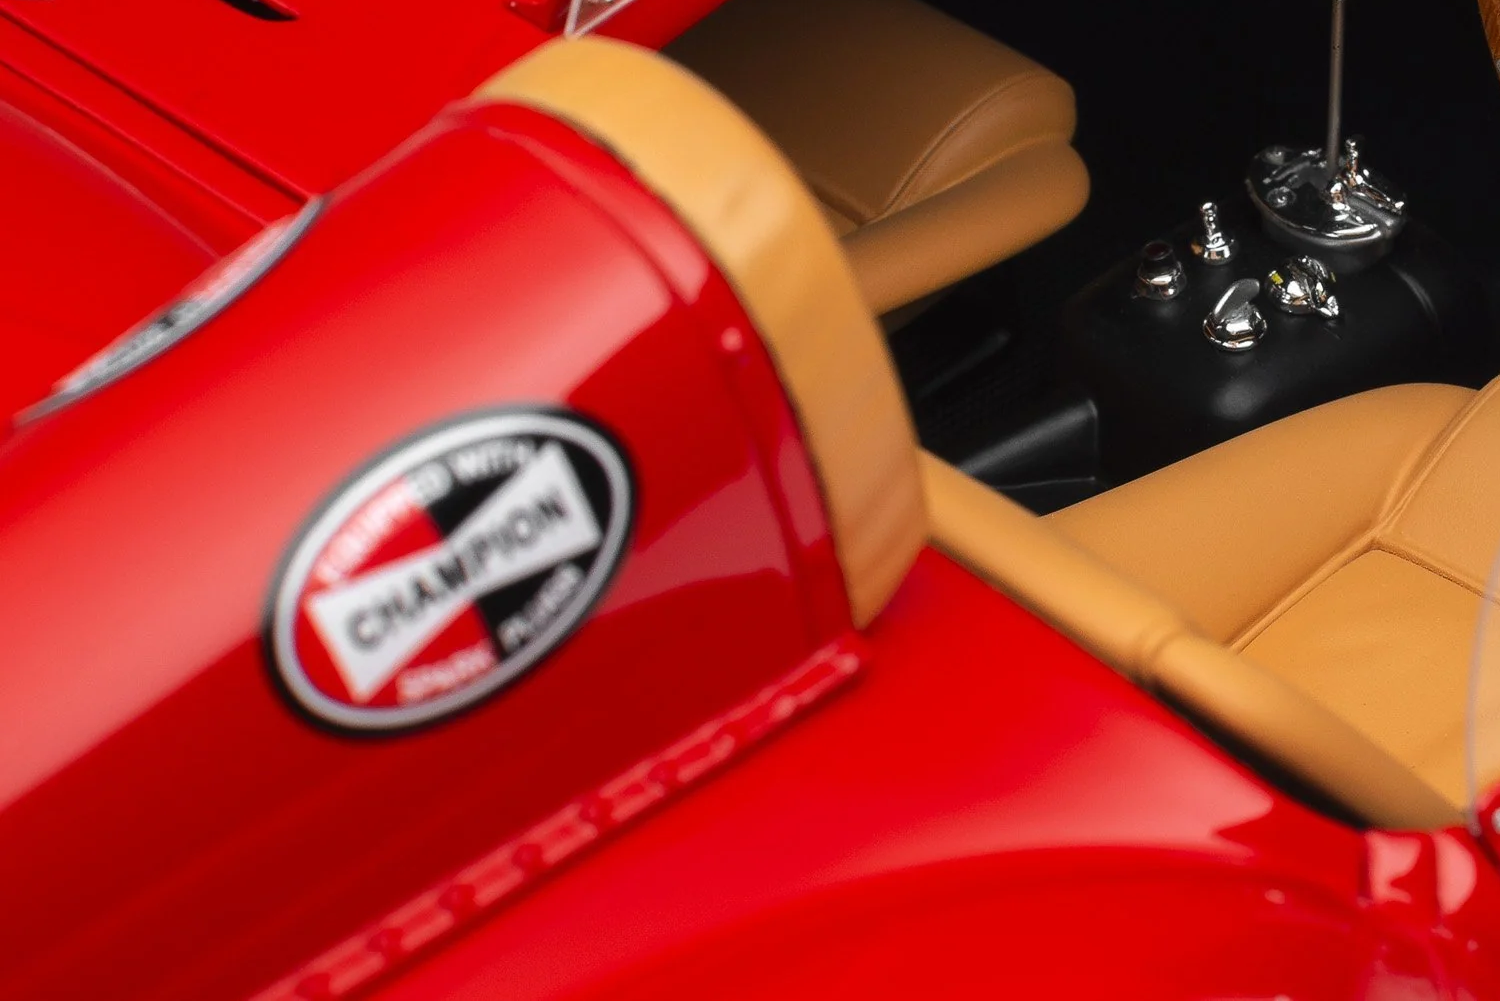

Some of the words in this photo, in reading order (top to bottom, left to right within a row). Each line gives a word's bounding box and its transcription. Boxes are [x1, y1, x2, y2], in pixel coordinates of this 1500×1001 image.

[451, 437, 536, 486] WITH
[344, 487, 570, 653] CHAMPION
[396, 637, 497, 705] SPARK
